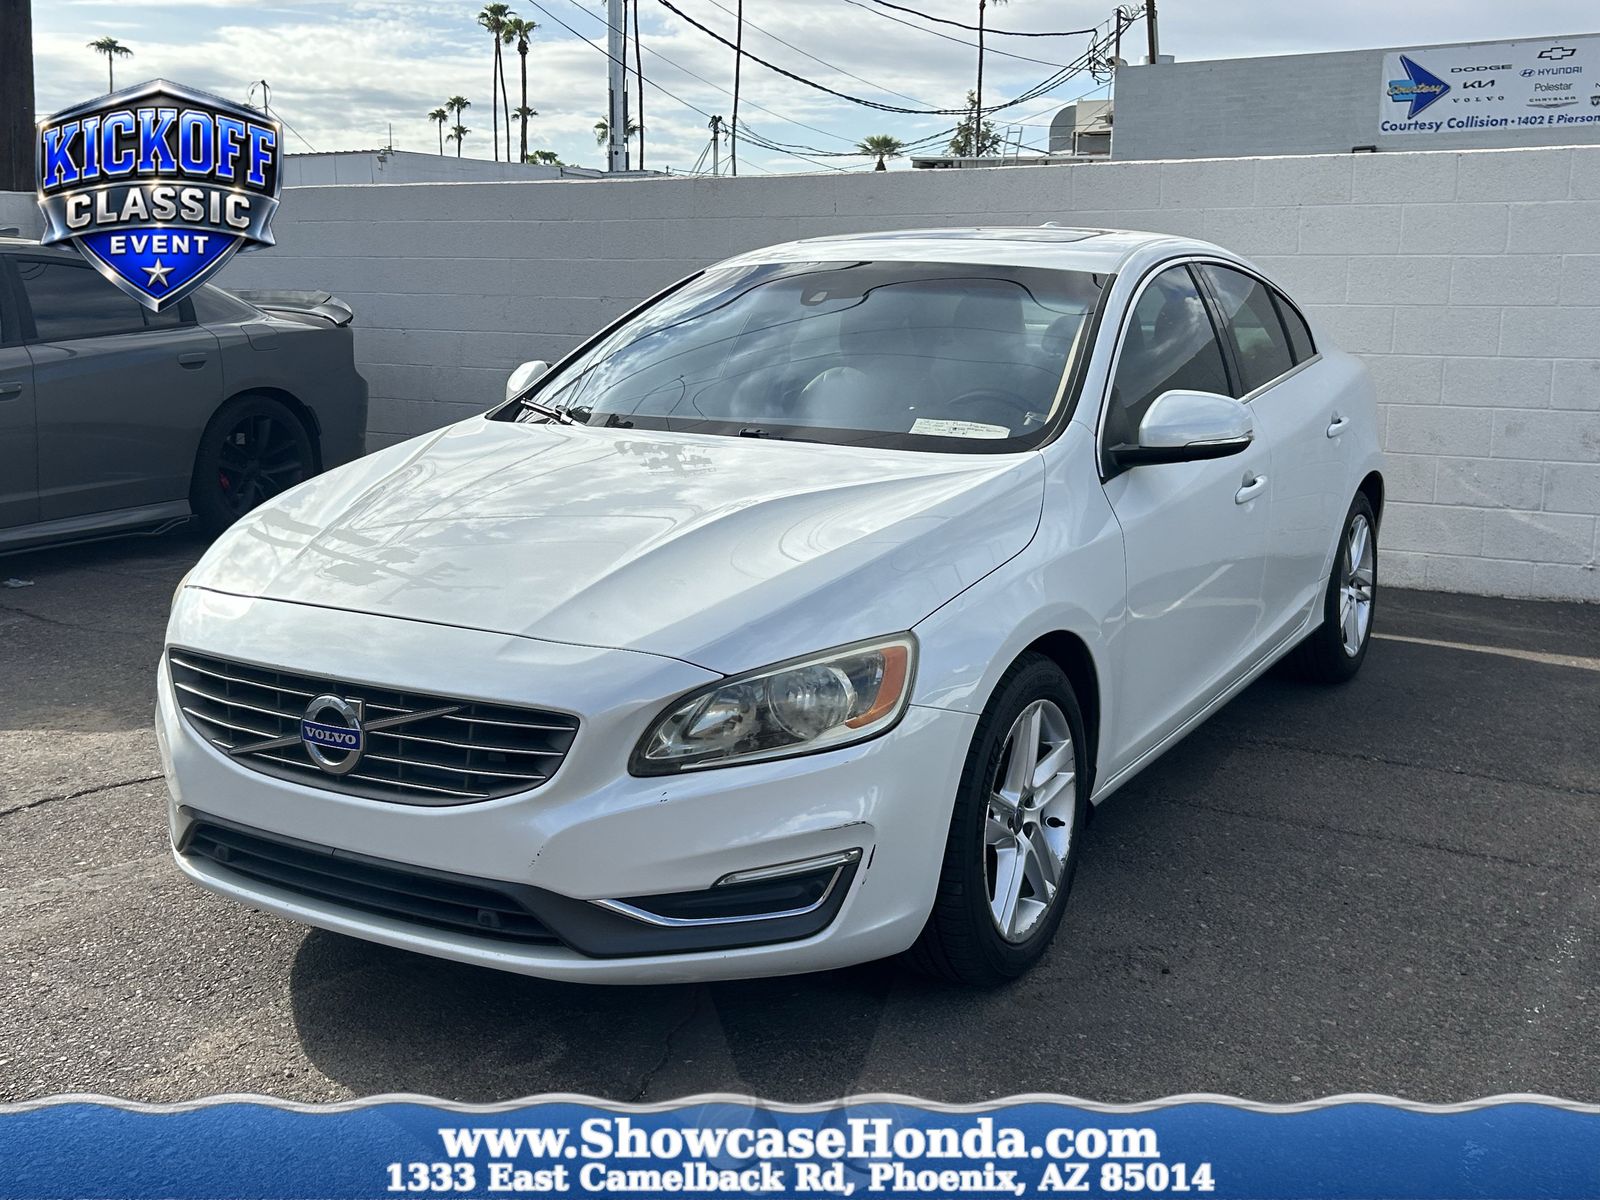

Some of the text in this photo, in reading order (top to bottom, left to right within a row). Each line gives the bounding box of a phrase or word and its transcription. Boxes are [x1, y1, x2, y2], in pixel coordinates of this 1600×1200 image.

[1450, 64, 1513, 74] DODGE
[1537, 66, 1583, 76] HYUNDAI
[1387, 81, 1443, 98] Courtesy
[1534, 82, 1574, 92] Polestar
[1452, 95, 1505, 104] VOLVO
[1381, 113, 1600, 133] Courtesy Collision 1402 E Pierson
[304, 726, 356, 745] VOLVO
